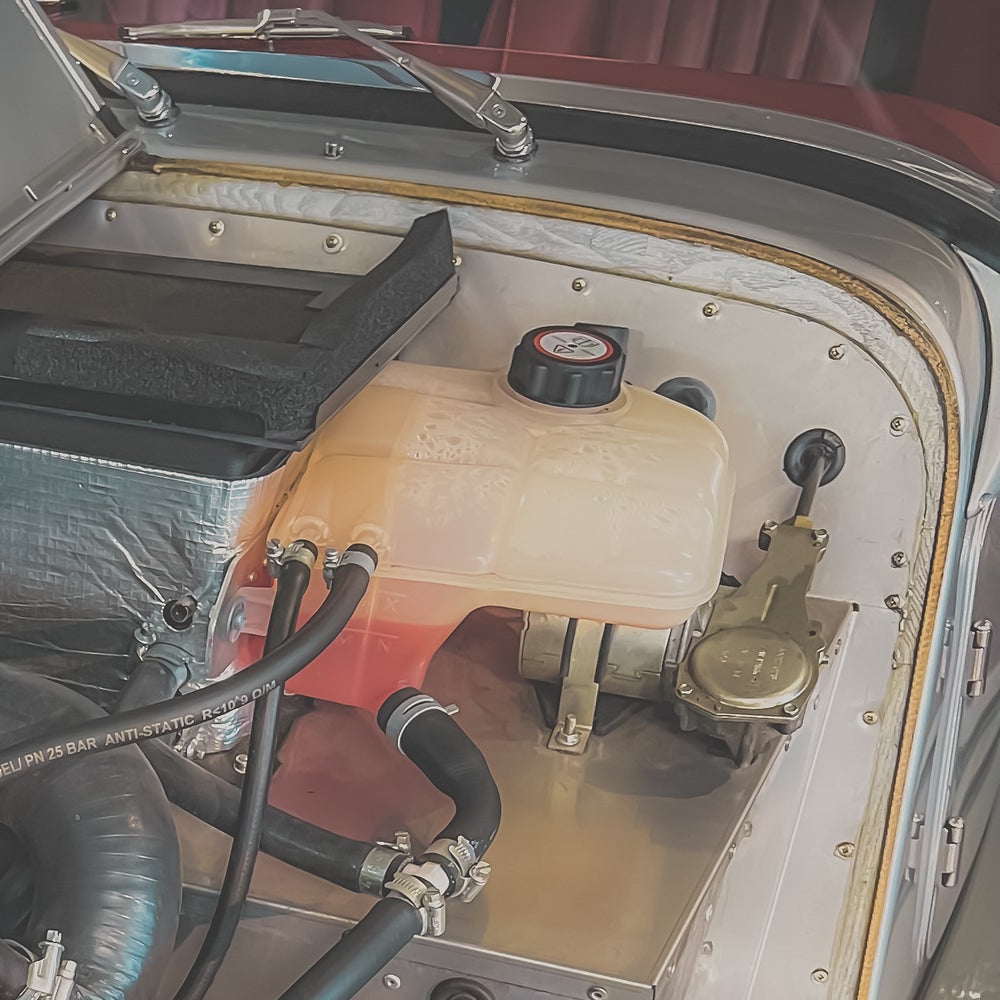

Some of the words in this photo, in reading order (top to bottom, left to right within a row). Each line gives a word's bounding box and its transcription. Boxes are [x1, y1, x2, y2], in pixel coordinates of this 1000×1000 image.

[25, 750, 45, 767] PN
[47, 746, 64, 761] 25
[66, 737, 98, 755] BAR
[105, 714, 195, 746] ANTI-STATIC
